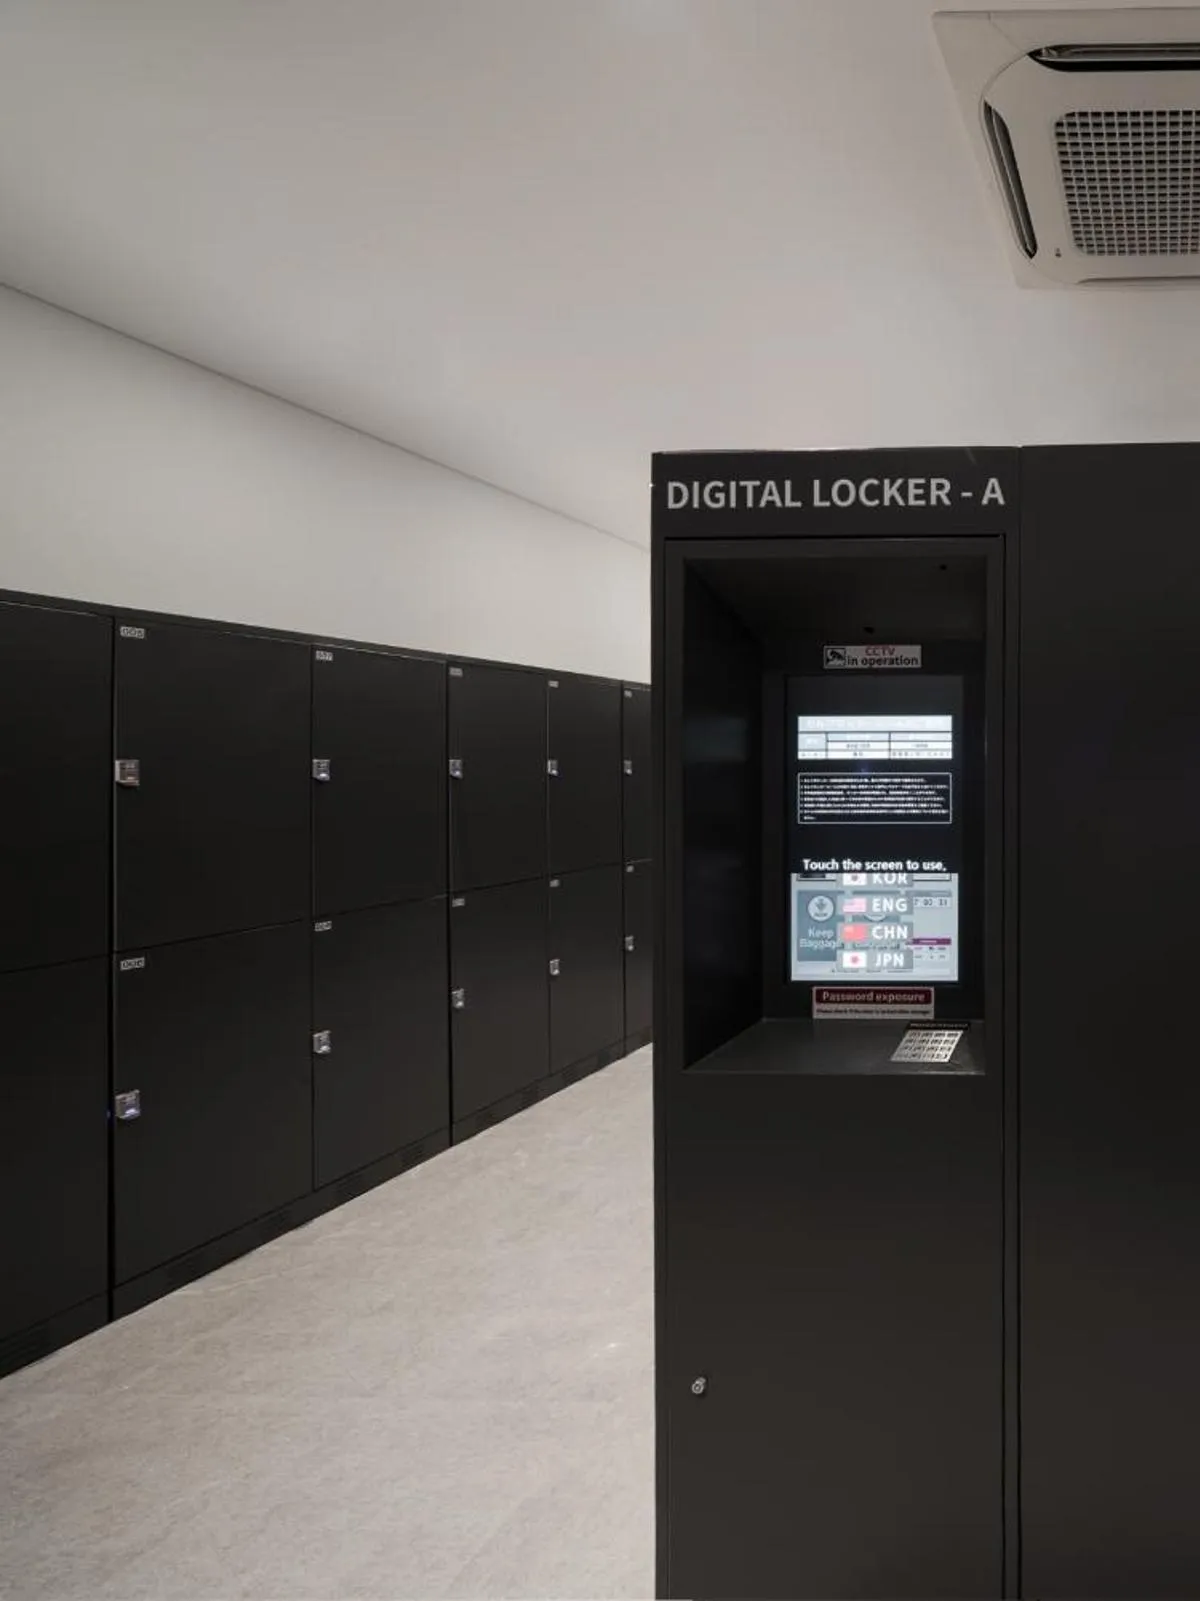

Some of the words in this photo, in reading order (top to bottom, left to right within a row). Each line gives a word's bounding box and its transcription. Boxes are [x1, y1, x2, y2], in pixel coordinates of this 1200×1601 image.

[667, 480, 802, 509] DIGITAL
[813, 478, 951, 507] LOCKER
[981, 478, 1005, 505] A
[865, 646, 895, 656] CCTV
[847, 656, 858, 666] in
[861, 656, 919, 668] operation
[803, 859, 839, 871] Touch
[842, 859, 861, 871] the
[864, 861, 903, 871] screen
[906, 860, 919, 871] to
[872, 872, 908, 885] KOR
[872, 898, 908, 912] ENG
[808, 928, 834, 940] Keep
[872, 926, 908, 940] CHN
[875, 953, 905, 966] JPN
[823, 990, 873, 1001] Password
[876, 991, 925, 1003] exposure
